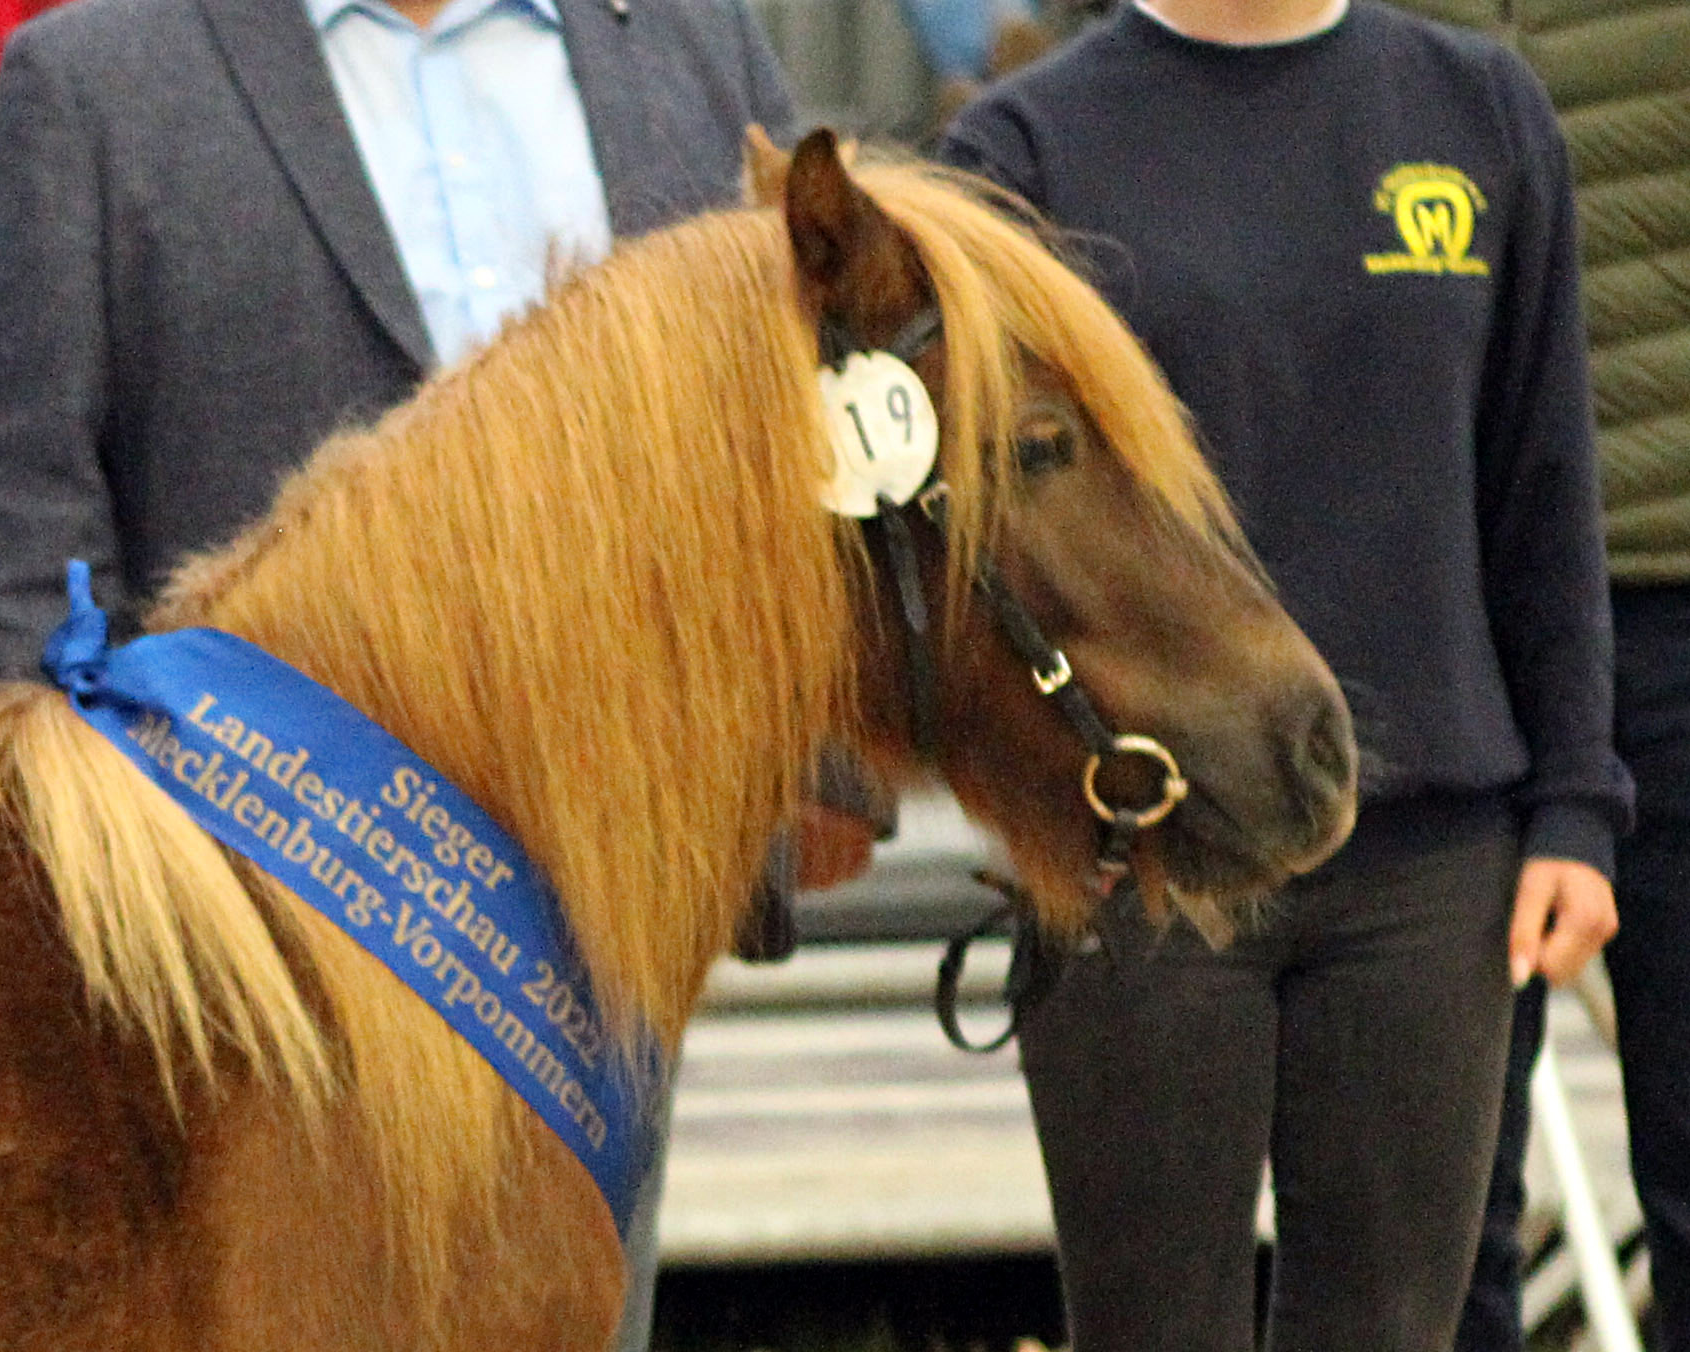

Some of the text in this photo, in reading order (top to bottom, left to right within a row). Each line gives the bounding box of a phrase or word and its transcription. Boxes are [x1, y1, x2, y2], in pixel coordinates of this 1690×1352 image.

[844, 384, 912, 462] 19
[186, 694, 520, 974] Landestierschau
[382, 767, 513, 888] Sieger
[126, 714, 607, 1151] Mecklenburg-Vorpommern
